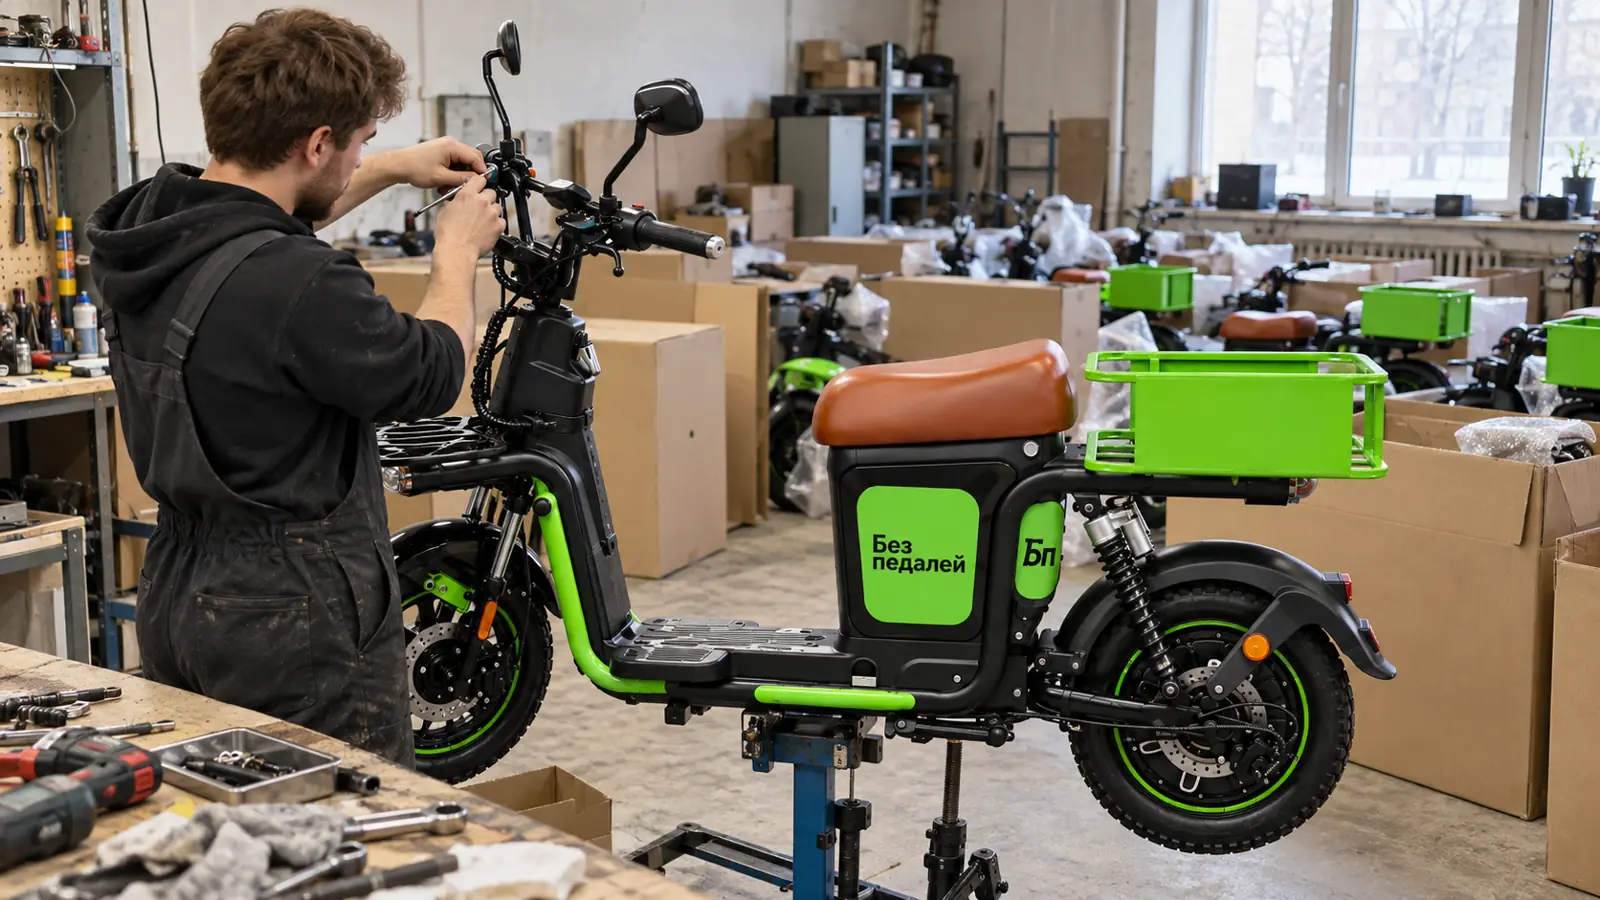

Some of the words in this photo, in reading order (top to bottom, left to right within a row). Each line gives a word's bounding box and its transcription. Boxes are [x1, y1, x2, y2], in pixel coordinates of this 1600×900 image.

[873, 534, 912, 554] Без
[1023, 538, 1056, 566] Бп
[873, 555, 965, 574] педалей
